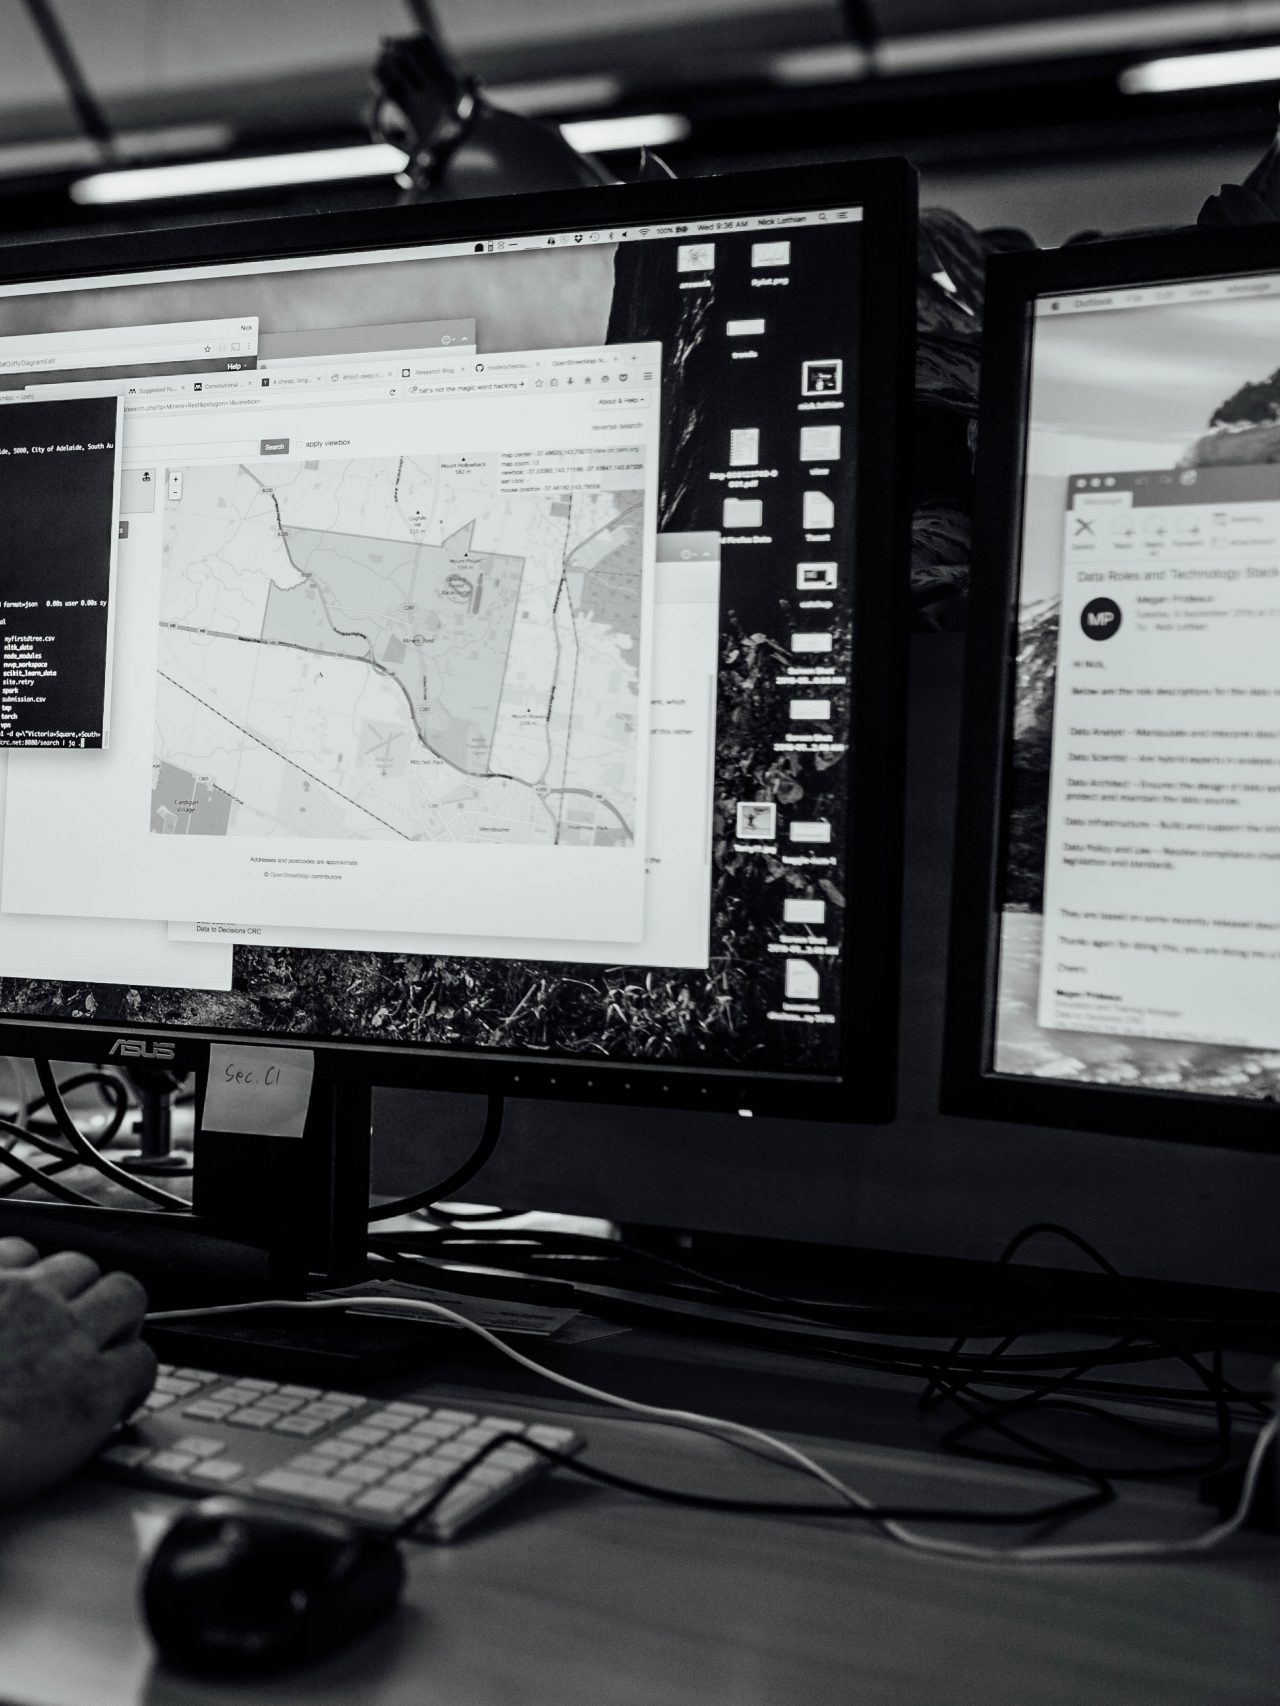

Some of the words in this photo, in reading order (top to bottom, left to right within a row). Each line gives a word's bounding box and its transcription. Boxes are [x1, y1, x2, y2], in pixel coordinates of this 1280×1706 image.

[777, 216, 806, 224] Lothian
[227, 363, 241, 371] Help
[457, 384, 475, 393] magic
[494, 382, 518, 391] hacking
[624, 397, 638, 405] Help
[265, 443, 285, 451] Search
[325, 439, 351, 447] viewbox
[13, 447, 29, 455] 5000,
[31, 446, 45, 454] City
[56, 444, 85, 452] Adelaide,
[1077, 571, 1105, 583] Data
[1109, 571, 1139, 582] Roles
[1144, 570, 1167, 581] and
[1170, 568, 1240, 582] Technology
[3, 600, 39, 609] format=json
[80, 599, 98, 607] 0.00s
[1087, 611, 1115, 627] MP
[3, 652, 43, 660] node_modules
[2, 669, 57, 677] scikit_learn_data
[2, 678, 35, 687] site.retry
[1, 687, 19, 695] spark
[0, 722, 11, 730] vpn
[67, 739, 76, 747] jq
[288, 857, 315, 865] postcodes
[218, 926, 246, 934] Decisions
[108, 1038, 176, 1060] ASUS
[225, 1063, 259, 1084] Sec.
